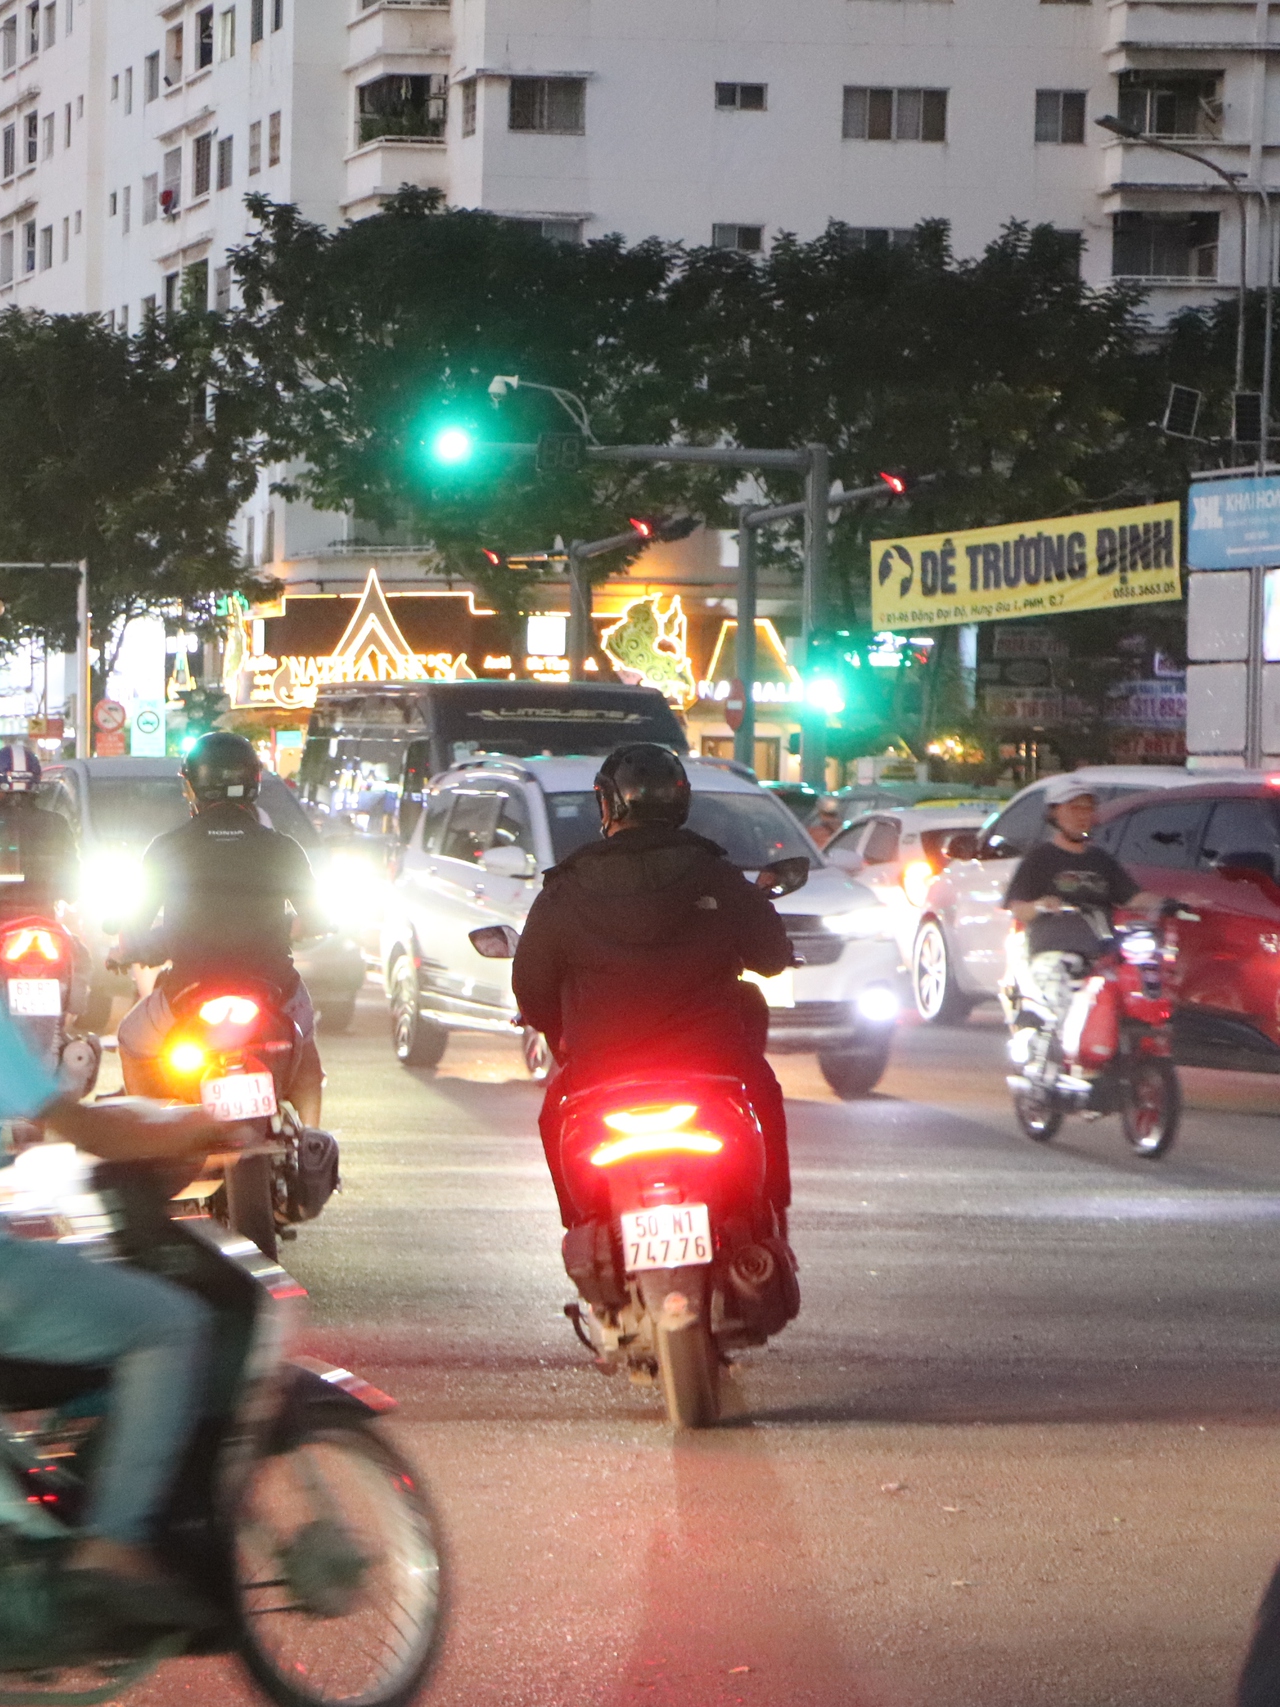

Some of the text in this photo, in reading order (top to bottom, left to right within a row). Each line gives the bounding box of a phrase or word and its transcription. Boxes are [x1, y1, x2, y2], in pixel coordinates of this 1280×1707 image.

[920, 518, 1175, 597] DÊ TRƯƠNG ĐỊNH
